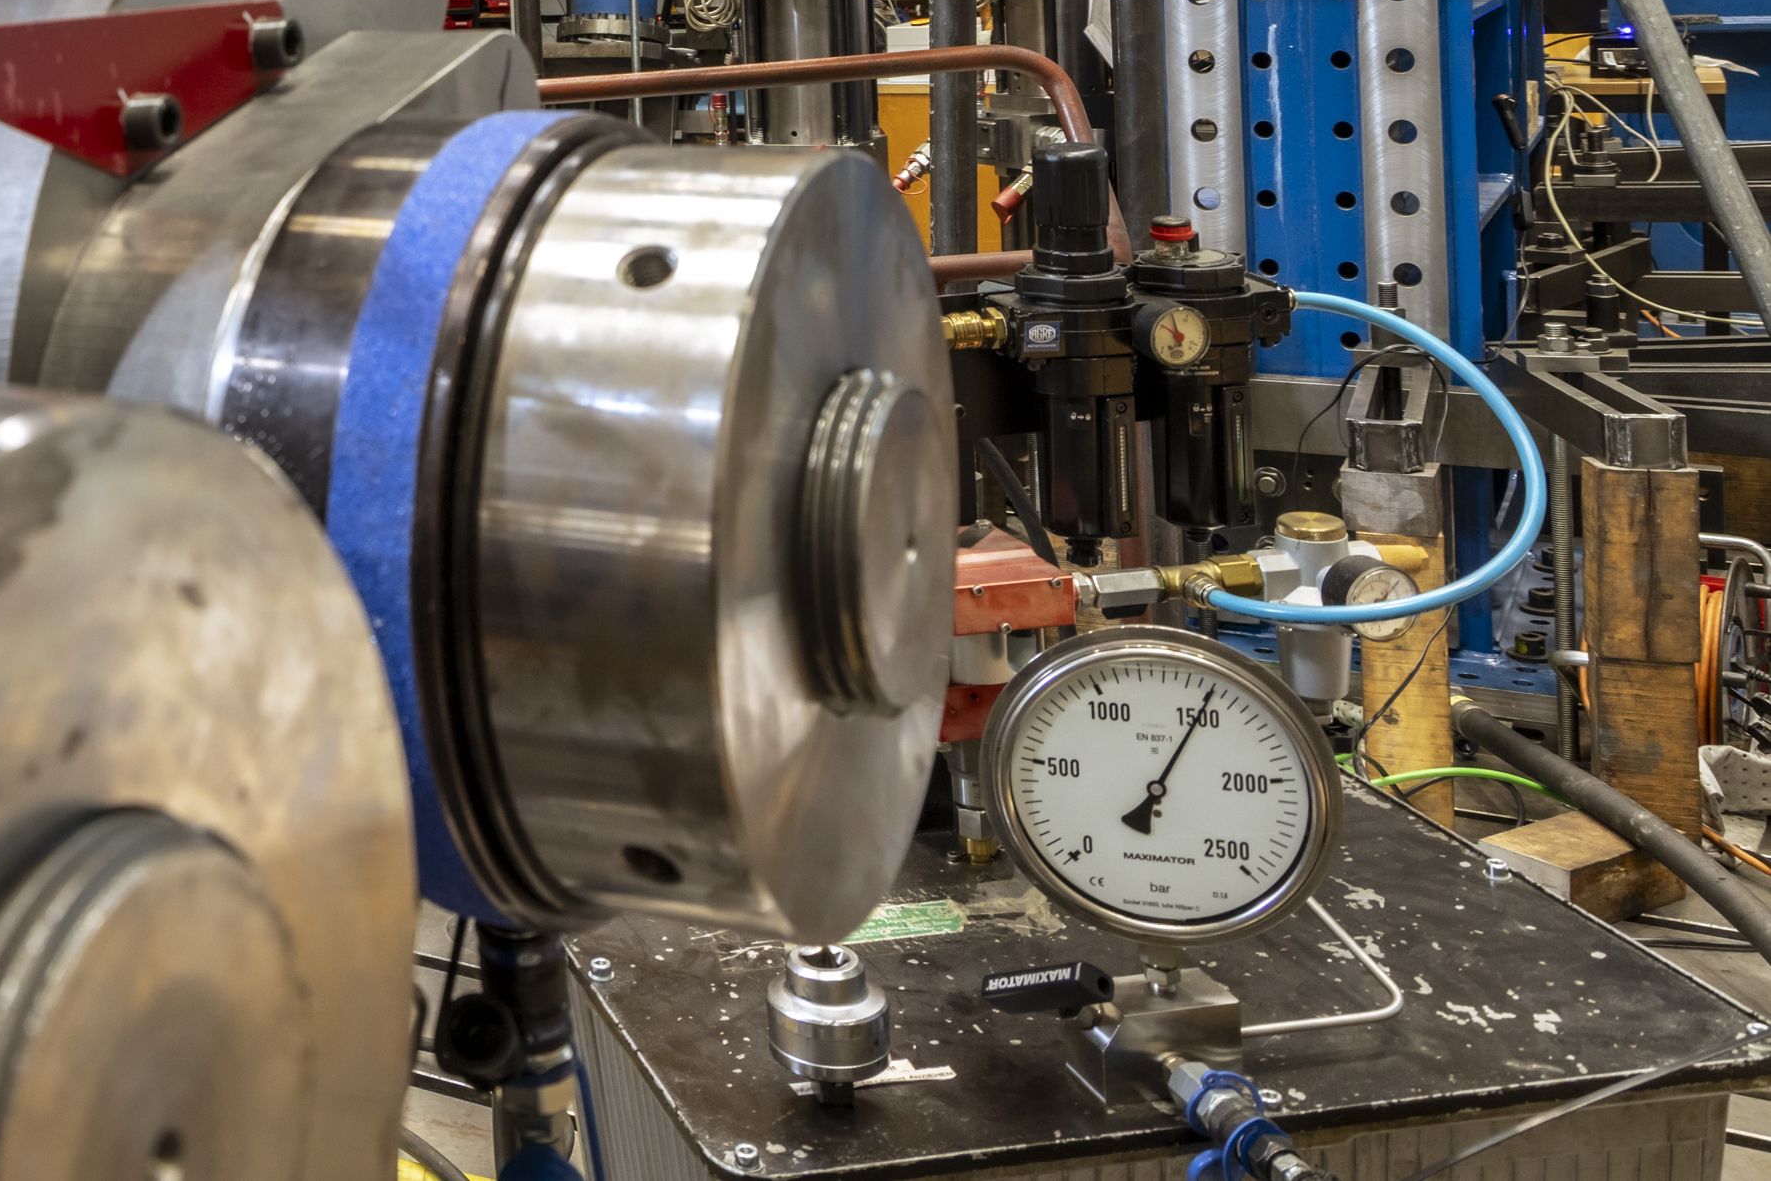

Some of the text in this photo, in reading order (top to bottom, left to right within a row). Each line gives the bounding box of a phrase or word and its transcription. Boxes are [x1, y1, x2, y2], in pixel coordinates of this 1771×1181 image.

[1088, 701, 1130, 722] 1000
[1176, 707, 1220, 728] 1500
[1136, 733, 1149, 741] EN
[1048, 757, 1080, 778] 500
[1221, 772, 1268, 794] 2000
[1083, 835, 1093, 854] 0
[1203, 838, 1250, 861] 2500
[1123, 852, 1196, 866] MAXIMATOR
[1149, 882, 1170, 893] bar
[987, 967, 1072, 991] MAXIMATOR
